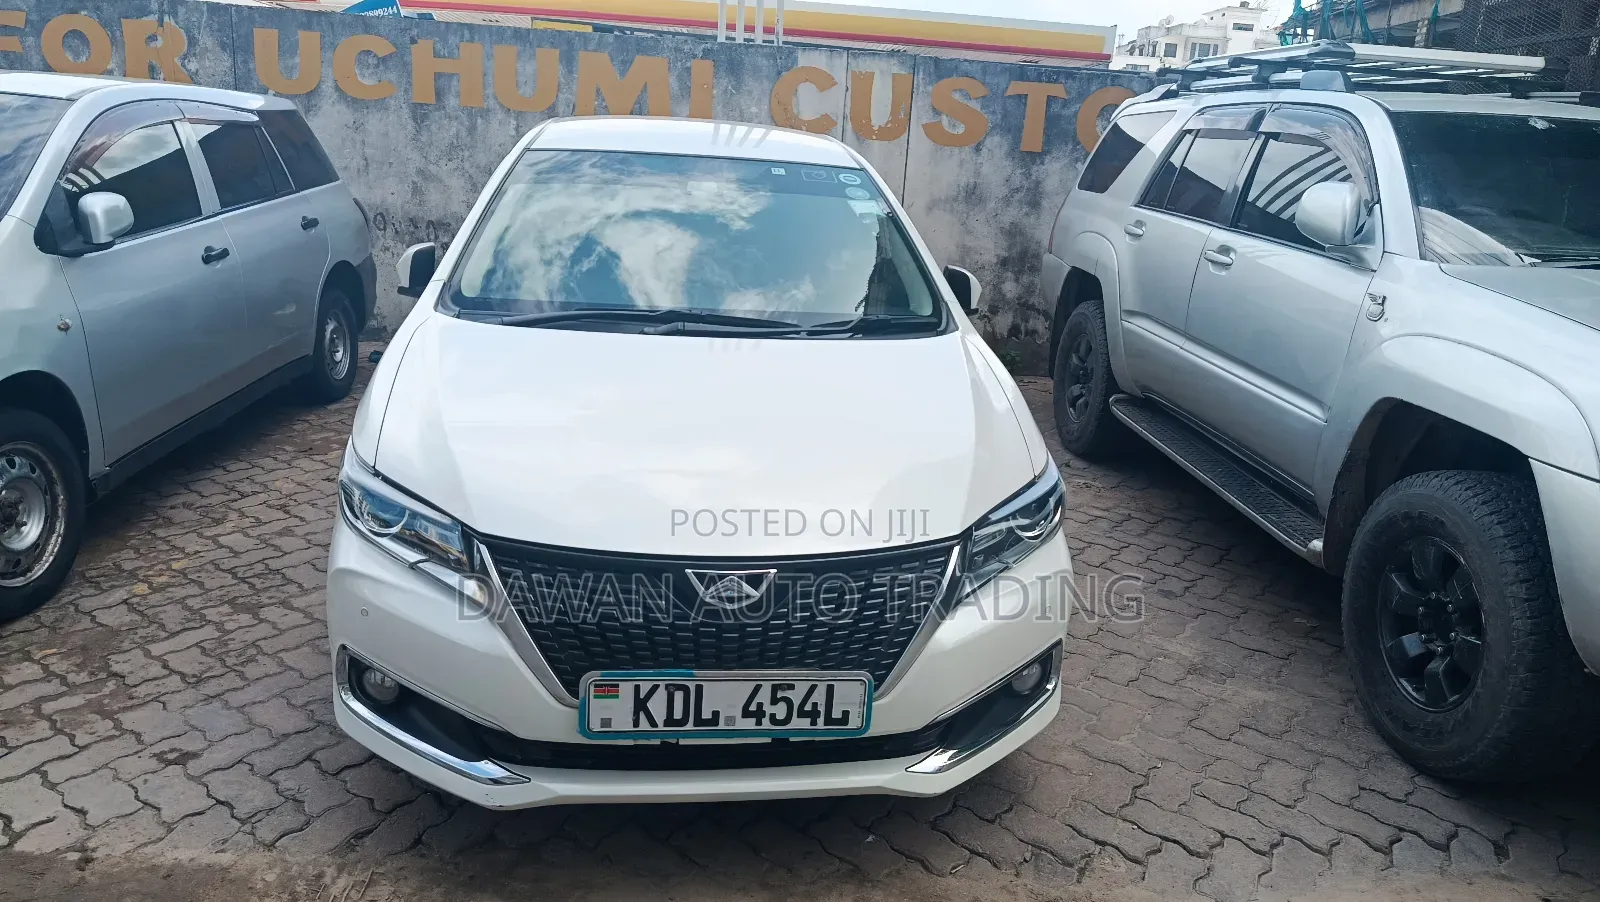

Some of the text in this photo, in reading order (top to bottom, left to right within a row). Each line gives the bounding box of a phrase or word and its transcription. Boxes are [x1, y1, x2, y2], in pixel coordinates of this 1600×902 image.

[254, 28, 714, 117] UCHUMI
[632, 683, 721, 728] KDL
[741, 683, 850, 727] 454L
